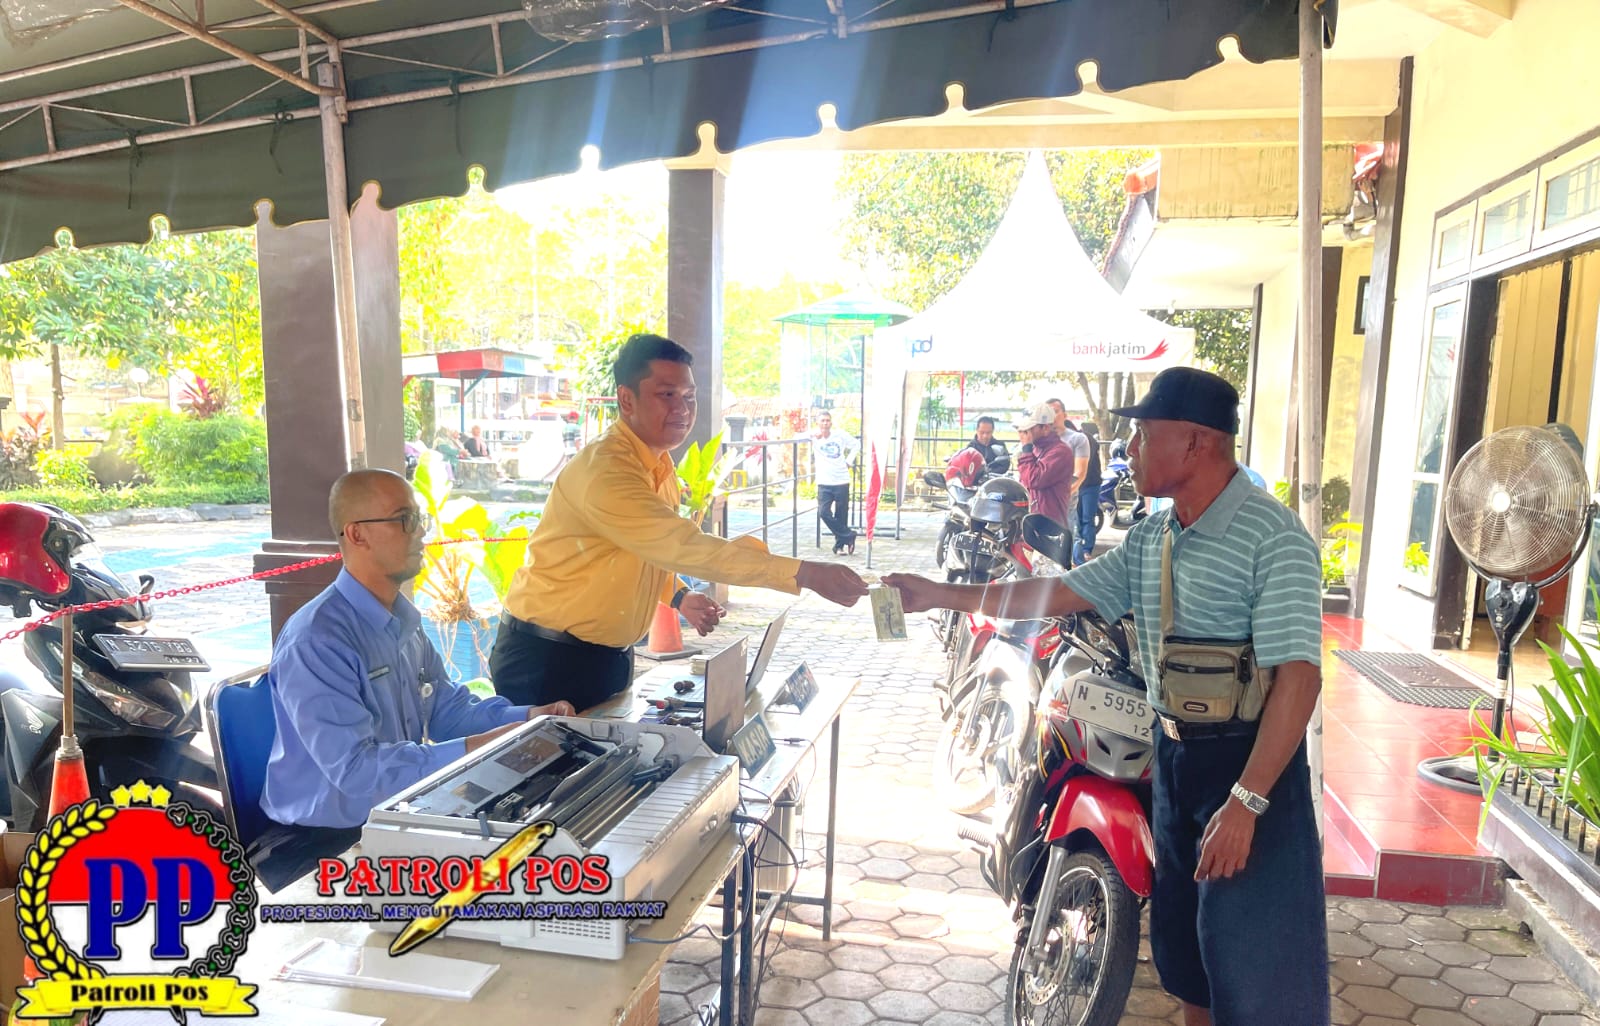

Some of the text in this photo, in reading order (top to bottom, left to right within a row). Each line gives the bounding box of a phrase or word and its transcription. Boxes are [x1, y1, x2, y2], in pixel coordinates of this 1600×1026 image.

[1072, 340, 1146, 358] bankjatim
[1078, 685, 1147, 718] N 5955
